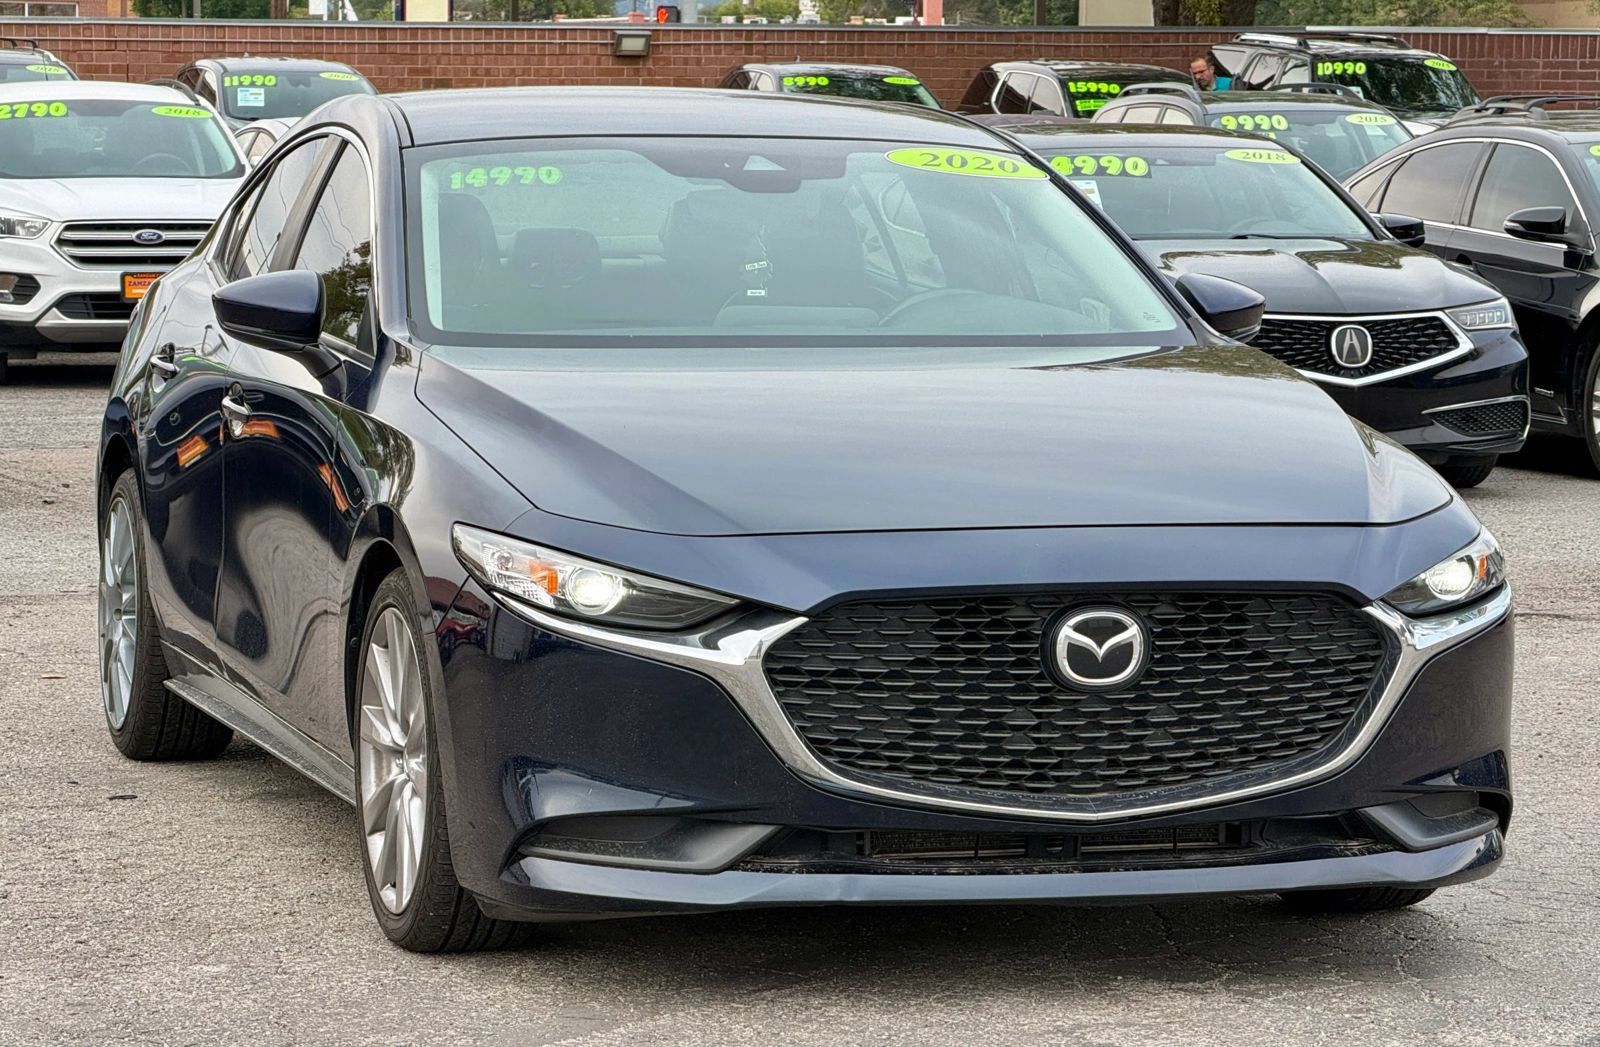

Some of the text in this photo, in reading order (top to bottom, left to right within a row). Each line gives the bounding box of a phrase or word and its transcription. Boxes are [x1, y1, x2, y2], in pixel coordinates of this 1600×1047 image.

[1317, 62, 1367, 76] 10990
[223, 75, 277, 87] 11990
[1068, 81, 1120, 94] 15990
[0, 101, 68, 119] 2790
[1221, 114, 1289, 131] 9990
[919, 152, 1020, 174] 2020
[1242, 151, 1287, 161] 2018
[1050, 155, 1149, 176] 4990
[450, 166, 562, 189] 14990
